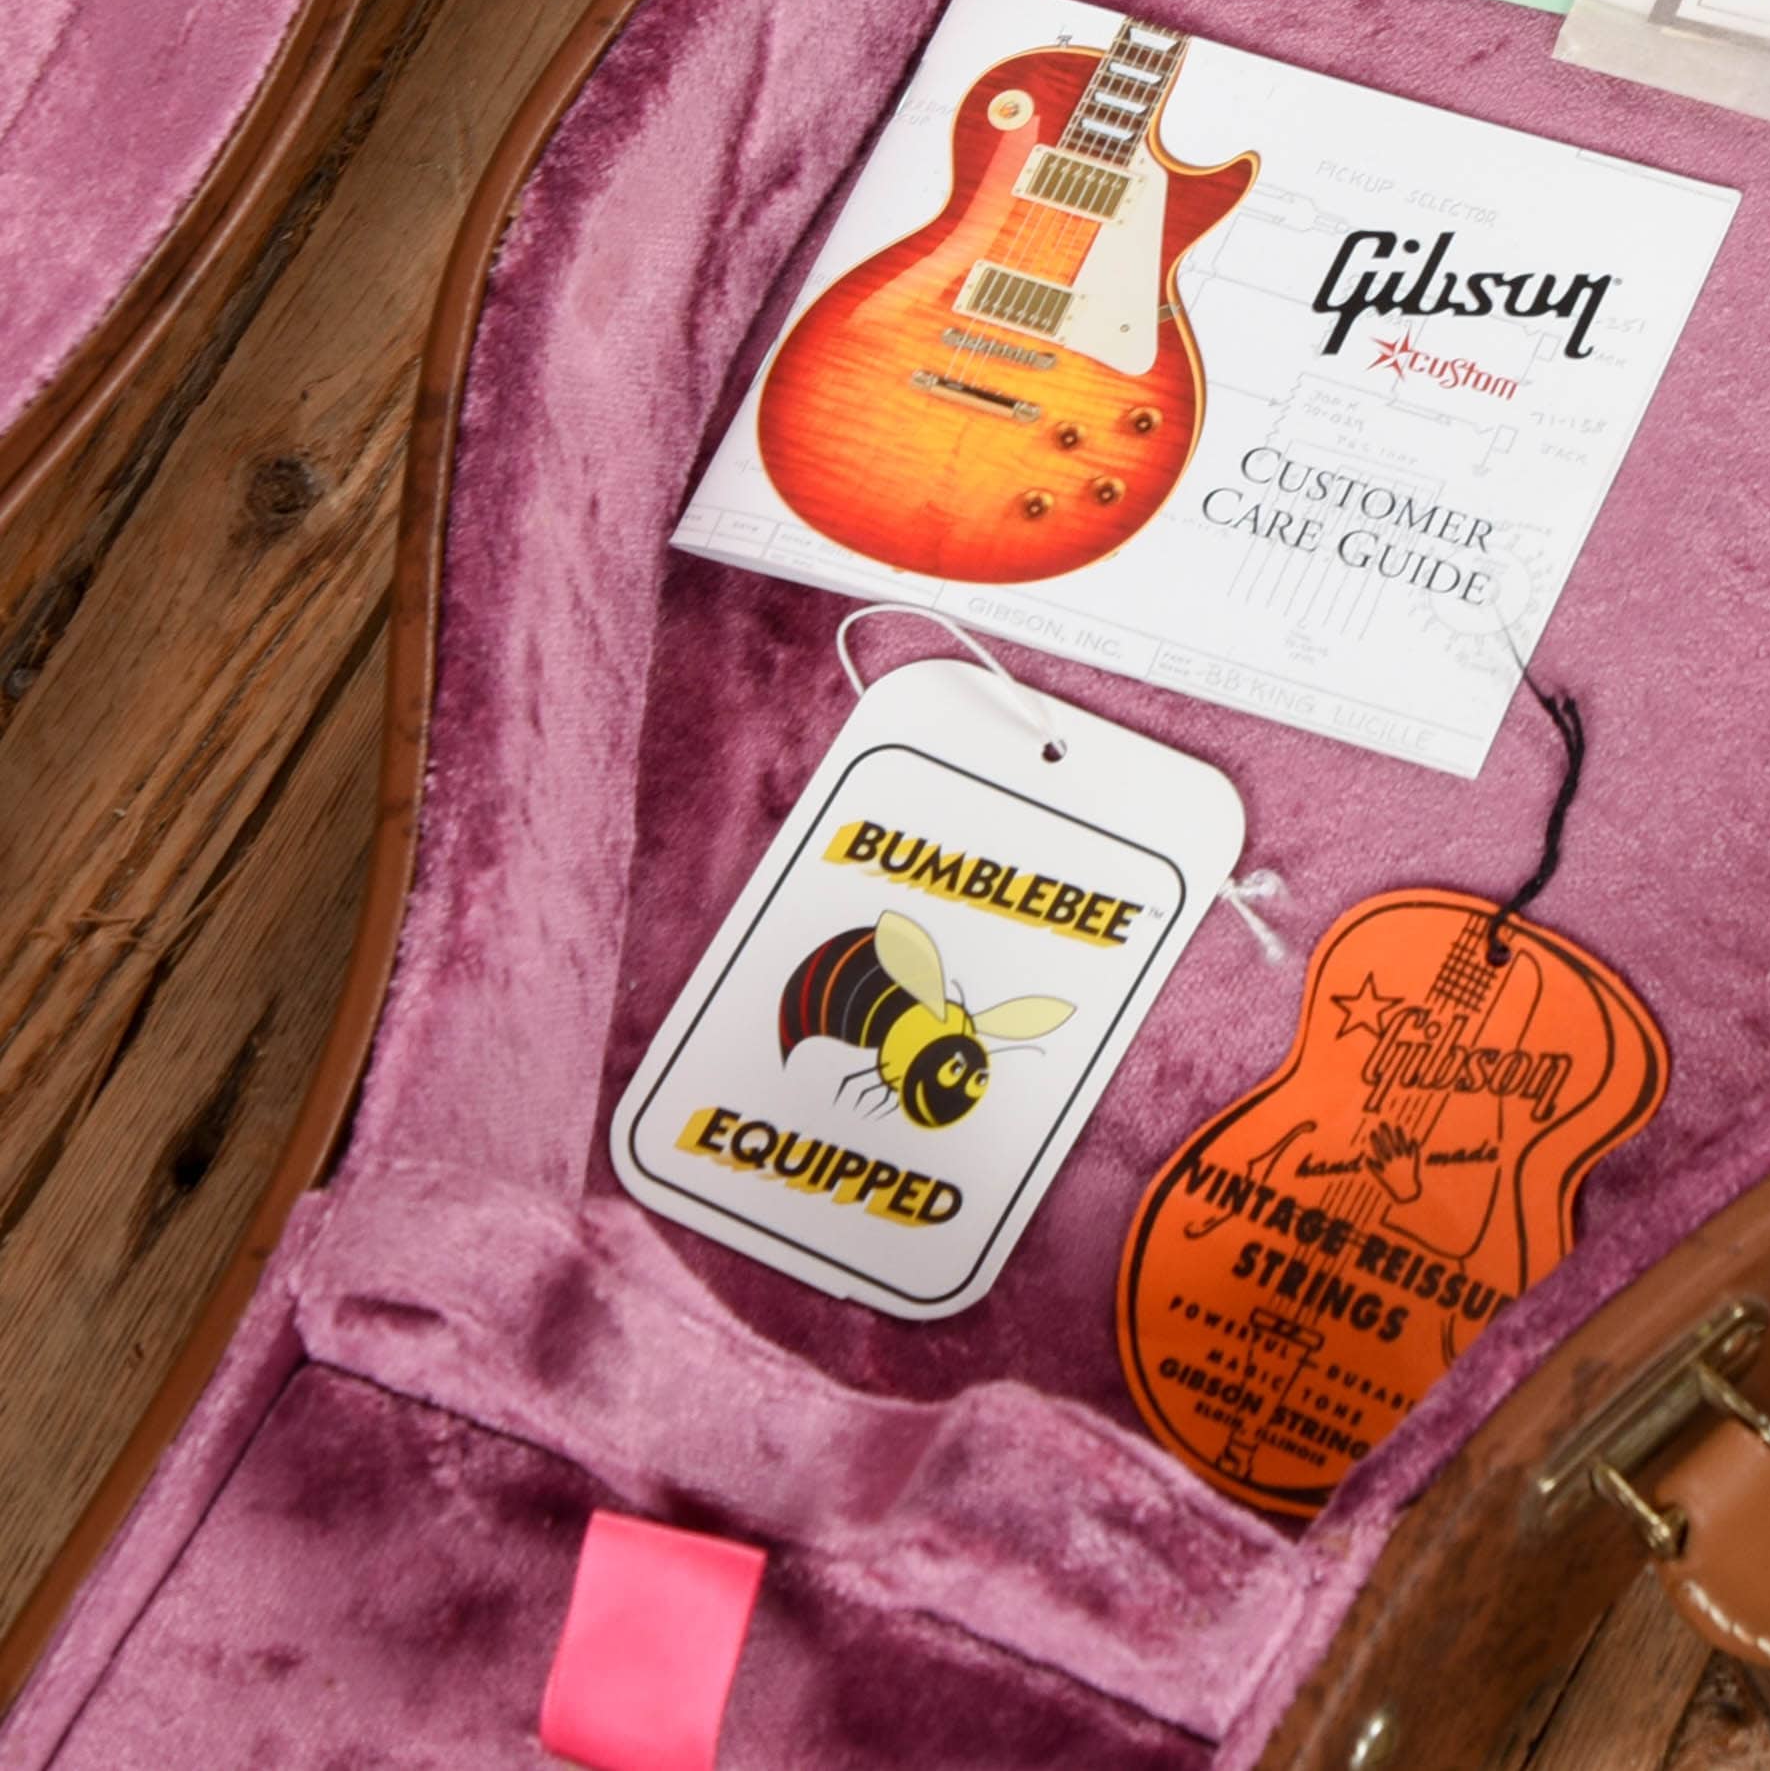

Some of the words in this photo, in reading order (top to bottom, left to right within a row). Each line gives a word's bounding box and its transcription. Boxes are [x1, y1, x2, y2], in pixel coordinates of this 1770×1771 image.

[1314, 158, 1394, 194] PICKUP
[1408, 189, 1500, 228] SELECTOR
[1311, 230, 1612, 359] Gibson
[1201, 486, 1323, 553] CARE
[1336, 528, 1493, 608] GUIDE
[1238, 445, 1496, 555] CUSTOMER
[967, 595, 1066, 645] GIBSON,
[1073, 624, 1124, 661] INC.
[1248, 672, 1321, 717] KING
[844, 820, 1143, 945] BUMBLEBEE
[1361, 1005, 1572, 1123] Gibson
[695, 1106, 964, 1225] EQUIPPED
[1184, 1154, 1354, 1253] VINTAGE
[1295, 1153, 1364, 1179] hand
[1425, 1143, 1500, 1167] made
[1169, 1296, 1291, 1360] POWERFUL
[1231, 1240, 1410, 1343] STRINGS
[1158, 1357, 1264, 1416] GIBSON
[1268, 1403, 1372, 1462] STRING
[1207, 1348, 1285, 1392] MAGIC
[1302, 1387, 1367, 1427] TONE
